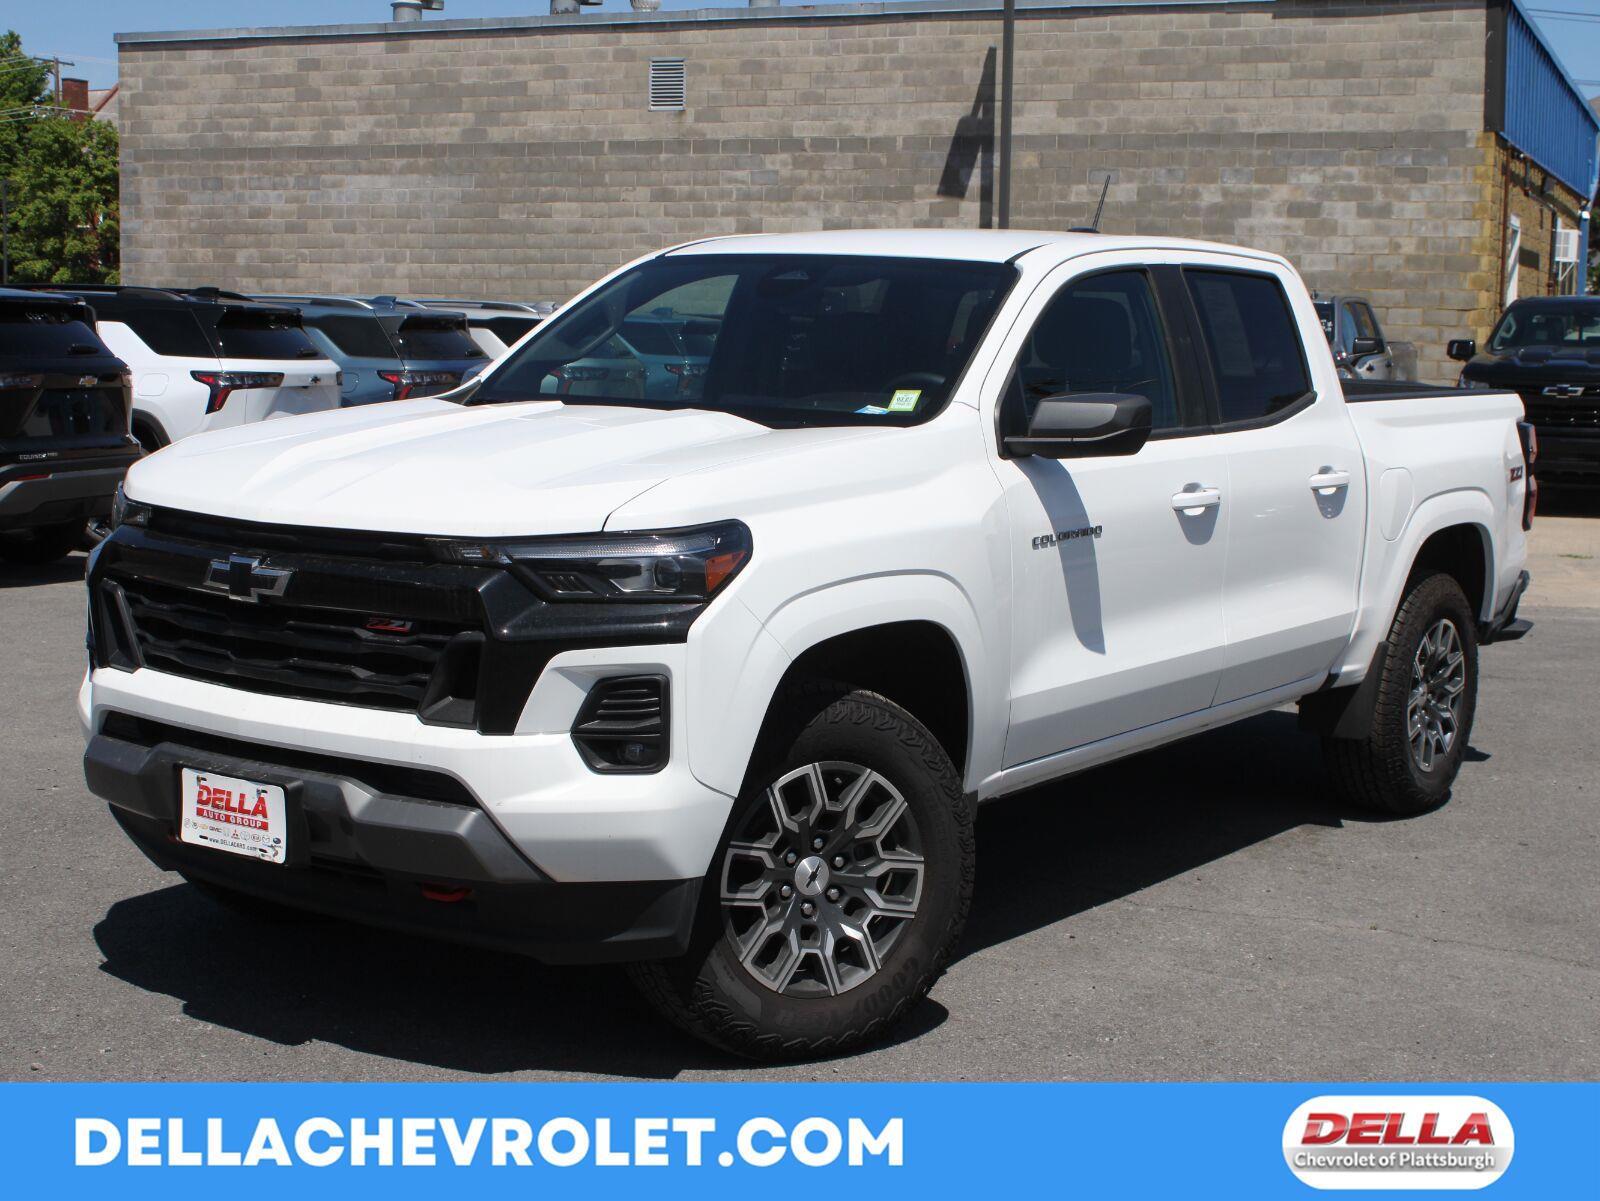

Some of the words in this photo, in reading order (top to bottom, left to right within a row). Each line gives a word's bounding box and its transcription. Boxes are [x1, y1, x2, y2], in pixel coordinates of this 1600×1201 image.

[1032, 525, 1103, 547] COLORADO
[196, 784, 268, 819] DELLA
[203, 809, 226, 821] AUTO
[230, 816, 262, 828] GROUP
